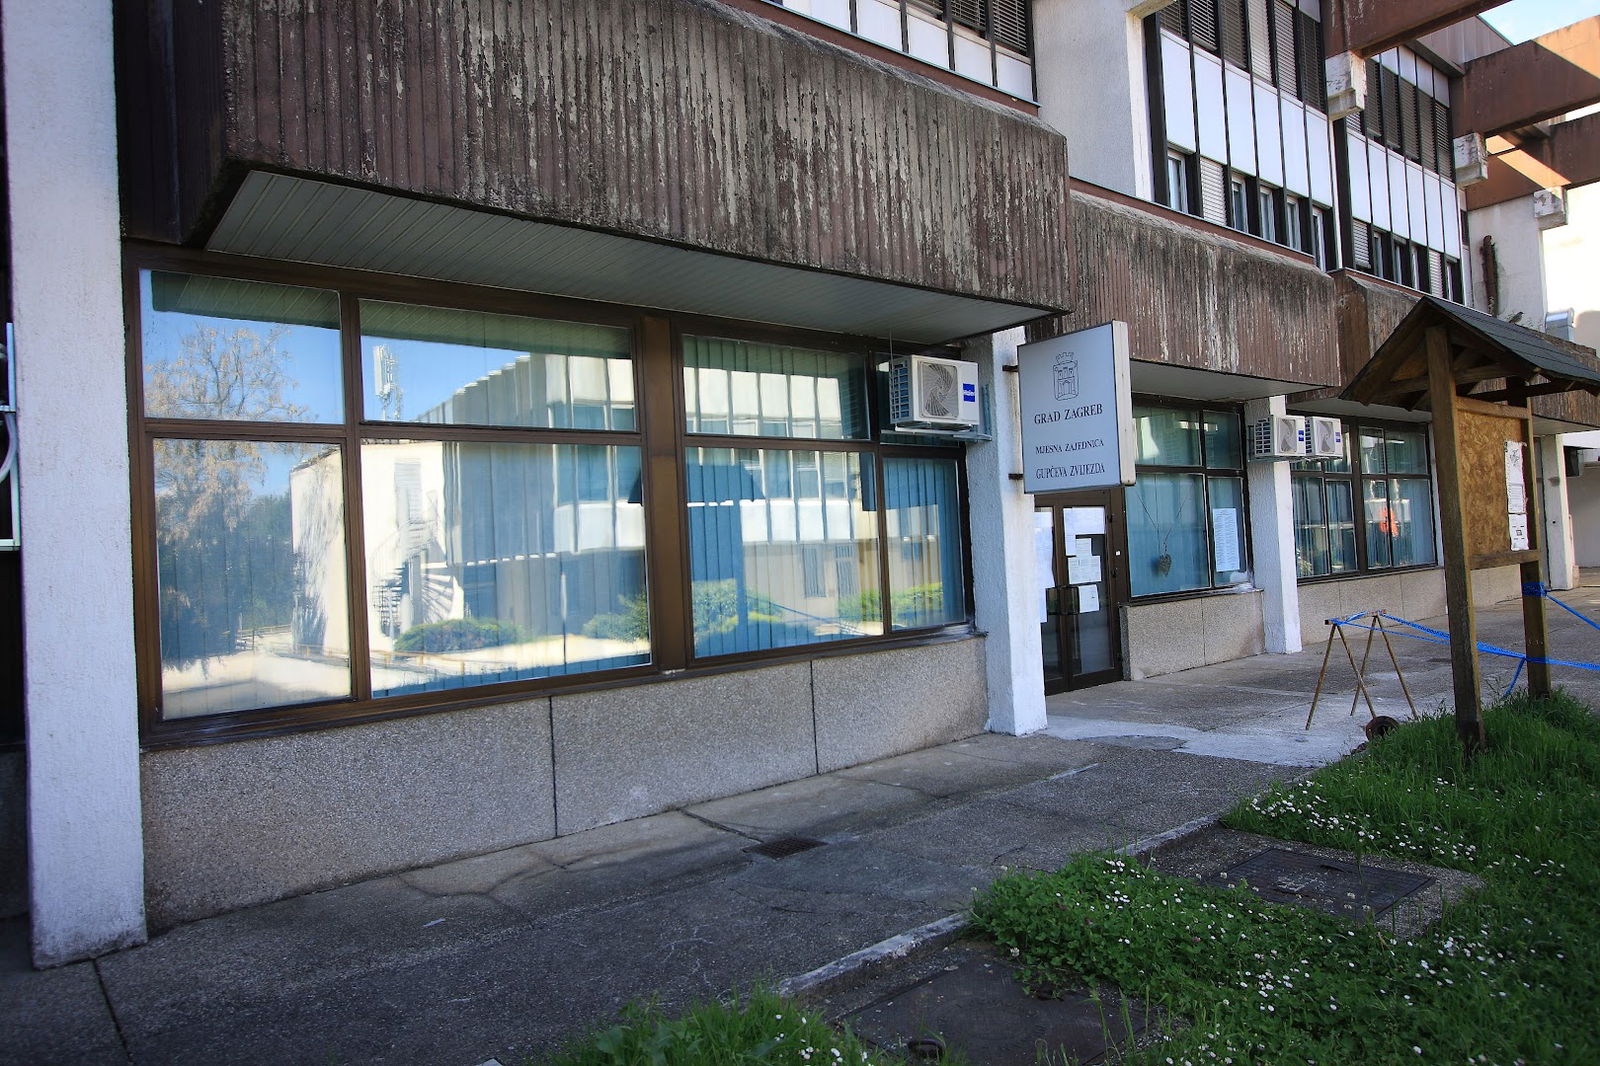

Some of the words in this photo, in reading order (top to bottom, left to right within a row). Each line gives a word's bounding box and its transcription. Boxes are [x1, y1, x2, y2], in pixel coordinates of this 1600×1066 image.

[1034, 411, 1061, 425] GRAD
[1064, 403, 1103, 420] ZAGREB
[1035, 445, 1063, 454] MJESNA
[1065, 439, 1104, 452] ZAJEDNICA
[1036, 466, 1067, 480] GUPČEVA
[1070, 462, 1105, 477] ZVIJEZDA
